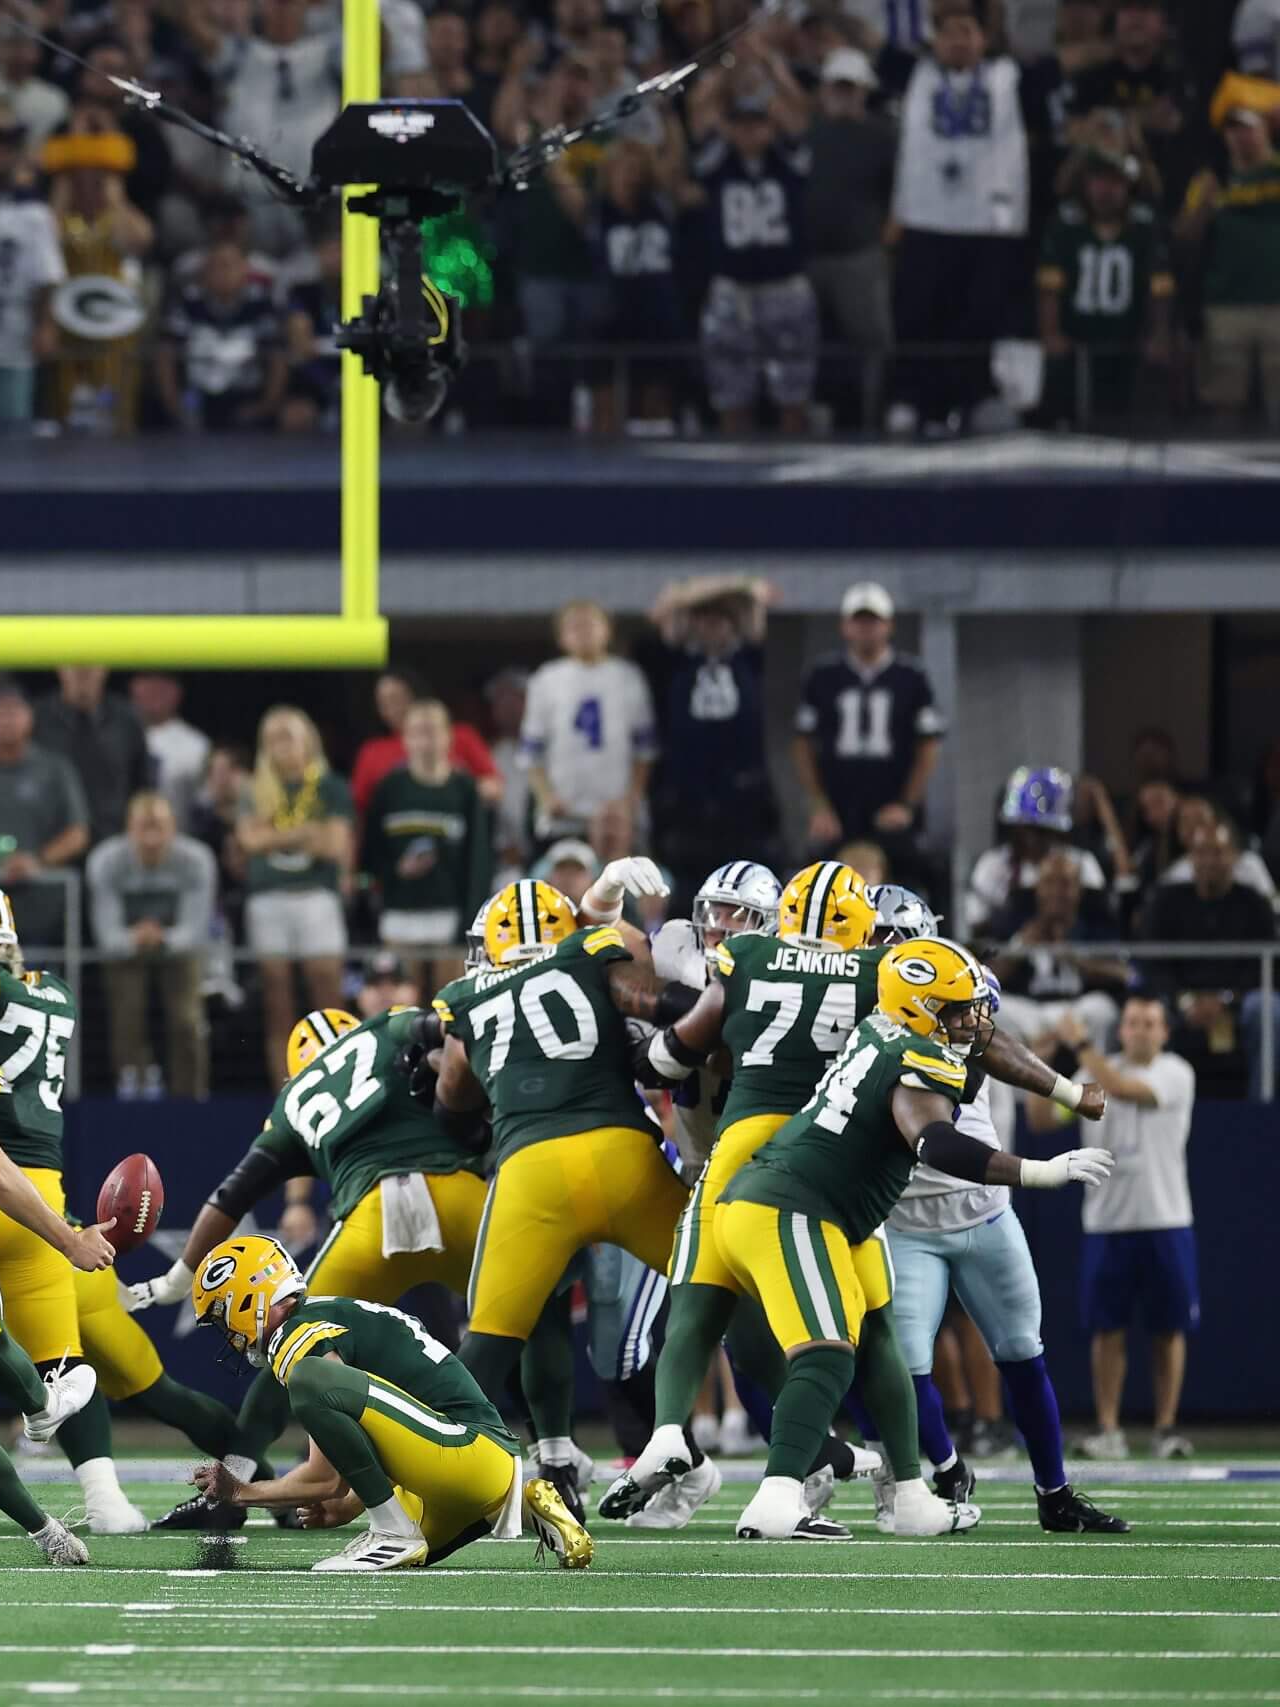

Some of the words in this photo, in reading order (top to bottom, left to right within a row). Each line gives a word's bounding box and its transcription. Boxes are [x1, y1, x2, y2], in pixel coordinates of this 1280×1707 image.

[1075, 244, 1132, 315] 10
[575, 699, 600, 749] 4
[837, 690, 893, 757] 11
[767, 948, 861, 978] JENKINS
[468, 968, 599, 1082] 70
[742, 979, 856, 1068] 74
[284, 1030, 381, 1149] 67
